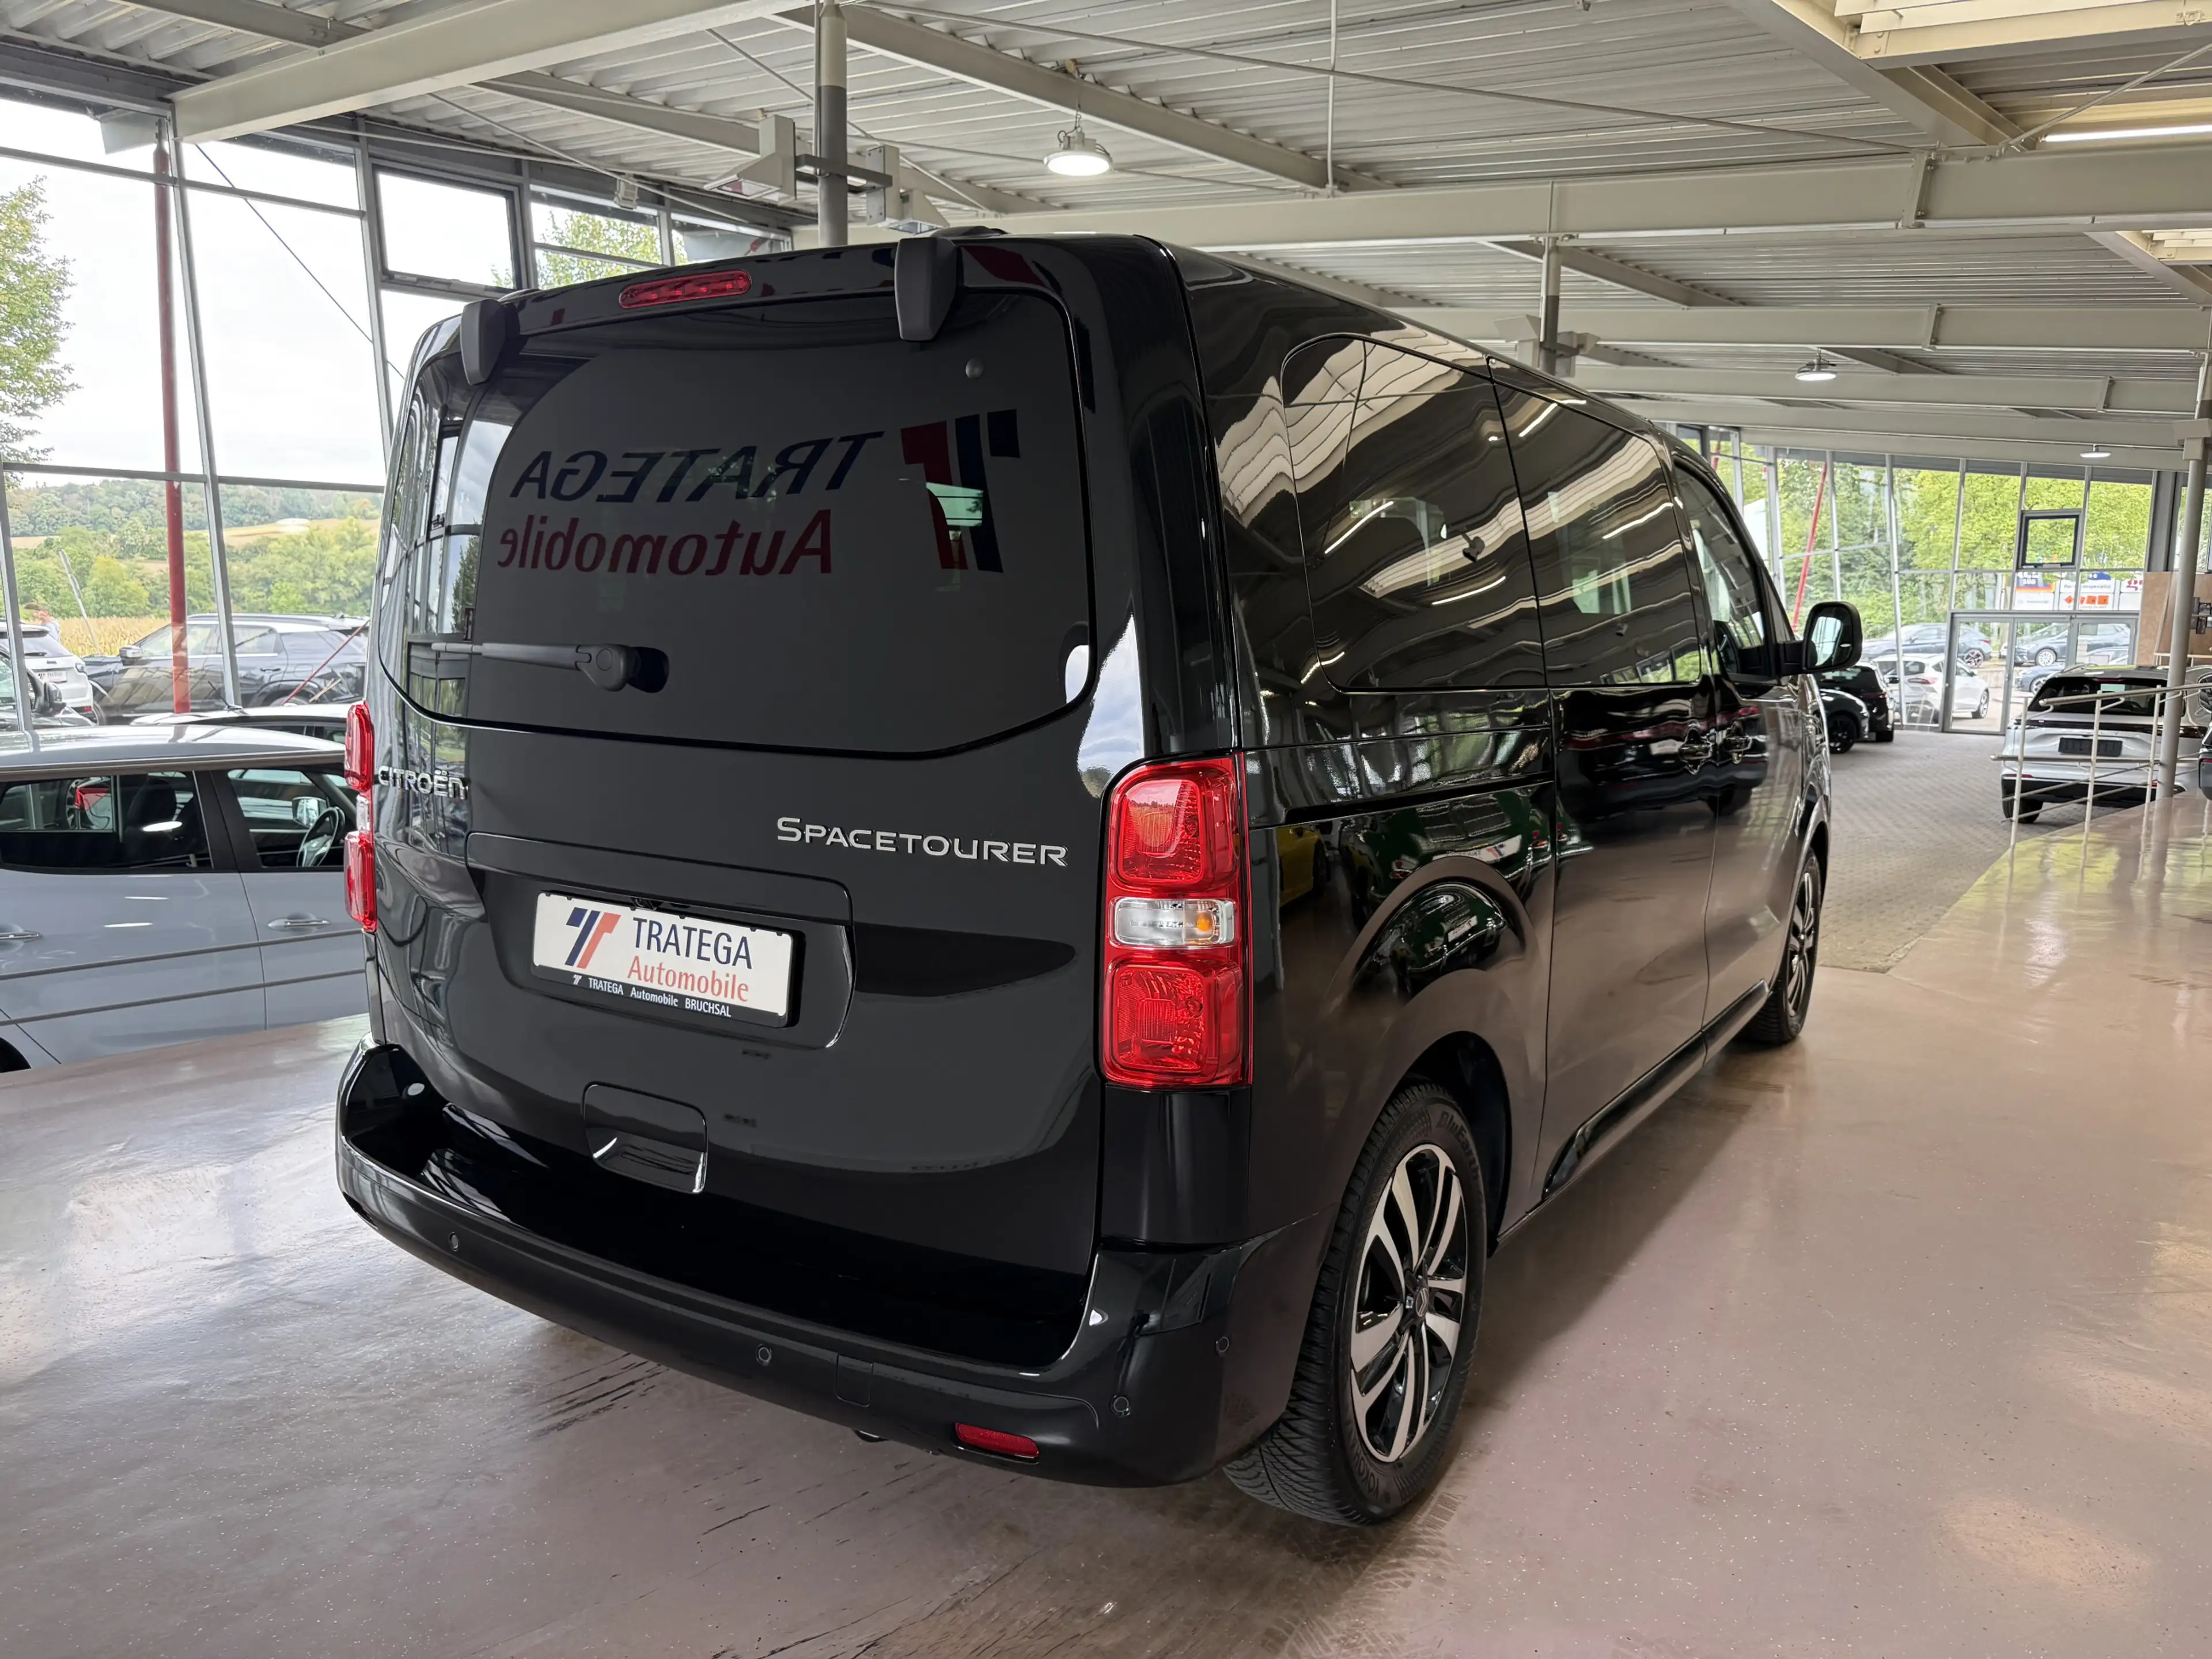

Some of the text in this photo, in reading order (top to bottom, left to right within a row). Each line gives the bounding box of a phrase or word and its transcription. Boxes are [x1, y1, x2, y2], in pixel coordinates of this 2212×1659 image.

[378, 766, 468, 800] CITROËN
[777, 817, 1067, 866] SPACETOURER
[633, 916, 752, 969] TRATEGA
[588, 978, 732, 1018] TRATEGA Automobile BRUCHSAL
[627, 956, 749, 1002] Automobile
